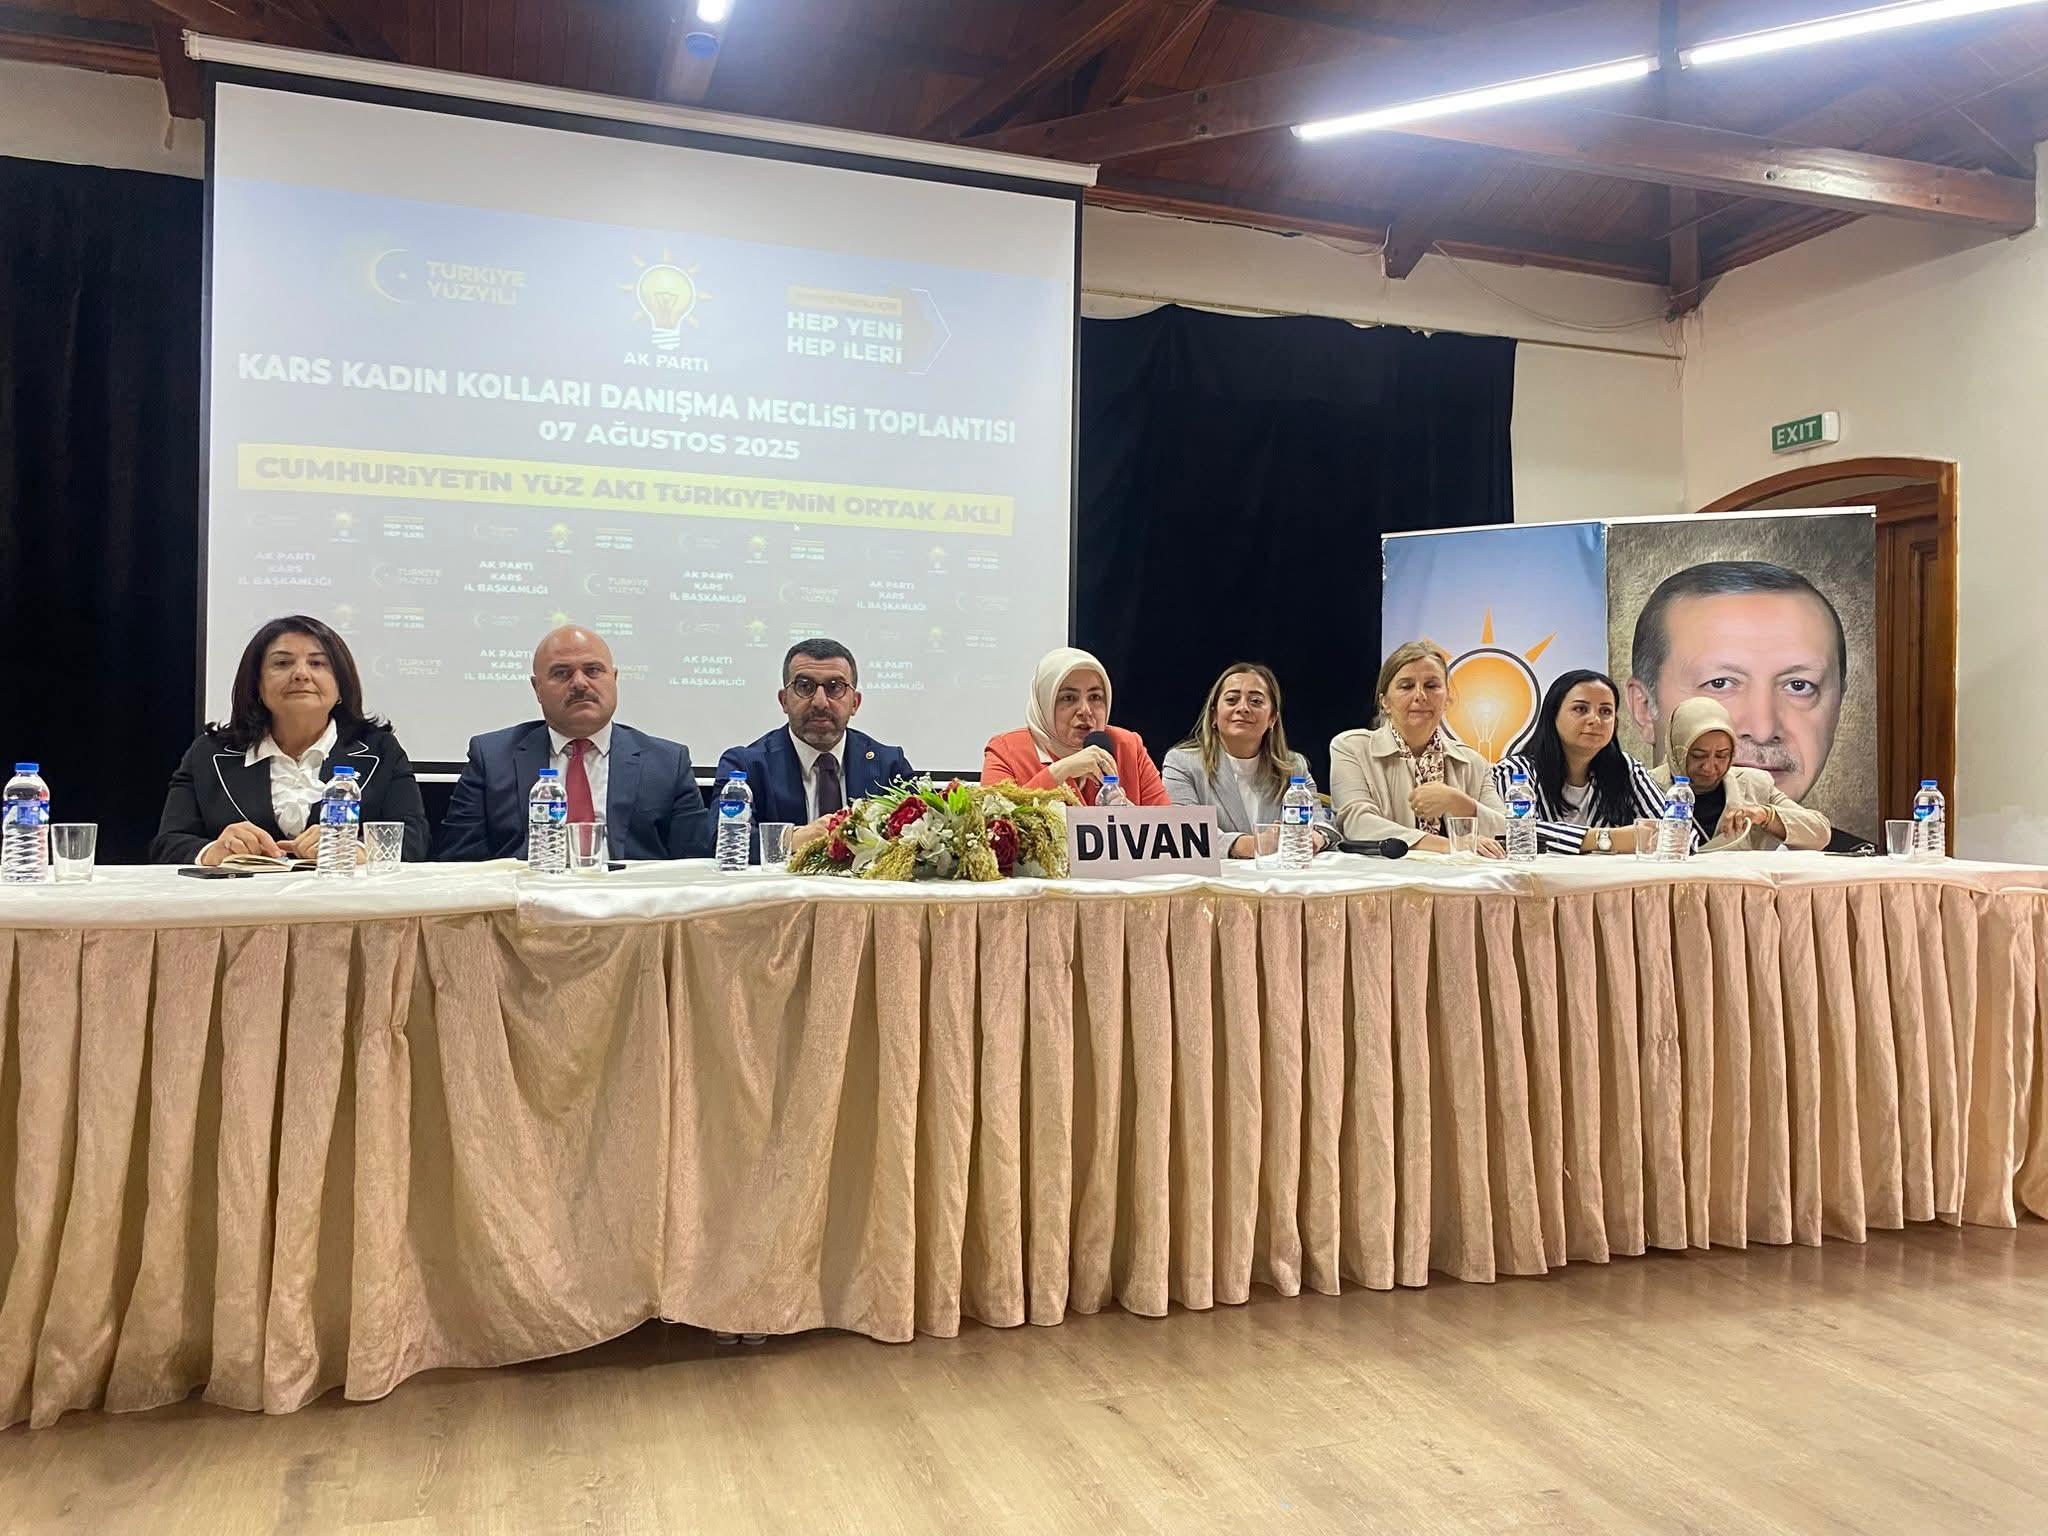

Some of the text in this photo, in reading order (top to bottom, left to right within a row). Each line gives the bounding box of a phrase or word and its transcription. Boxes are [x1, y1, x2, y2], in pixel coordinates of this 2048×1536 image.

[787, 311, 839, 333] HEP
[623, 350, 650, 368] AK
[787, 335, 836, 357] HEP
[238, 352, 1016, 444] KARS KADIN KOLLARI DANIŞMA MECLİSİ TOPLANTISI
[539, 419, 801, 461] 07 AĞUSTOS 2025
[1776, 420, 1817, 446] EXIT
[255, 456, 512, 492] CUMHURİYETİN
[521, 472, 583, 498] YÜZ
[592, 478, 646, 502] AKI
[844, 494, 936, 521] ORTAK
[943, 503, 1001, 526] AKLI
[1075, 814, 1211, 861] DİVAN
